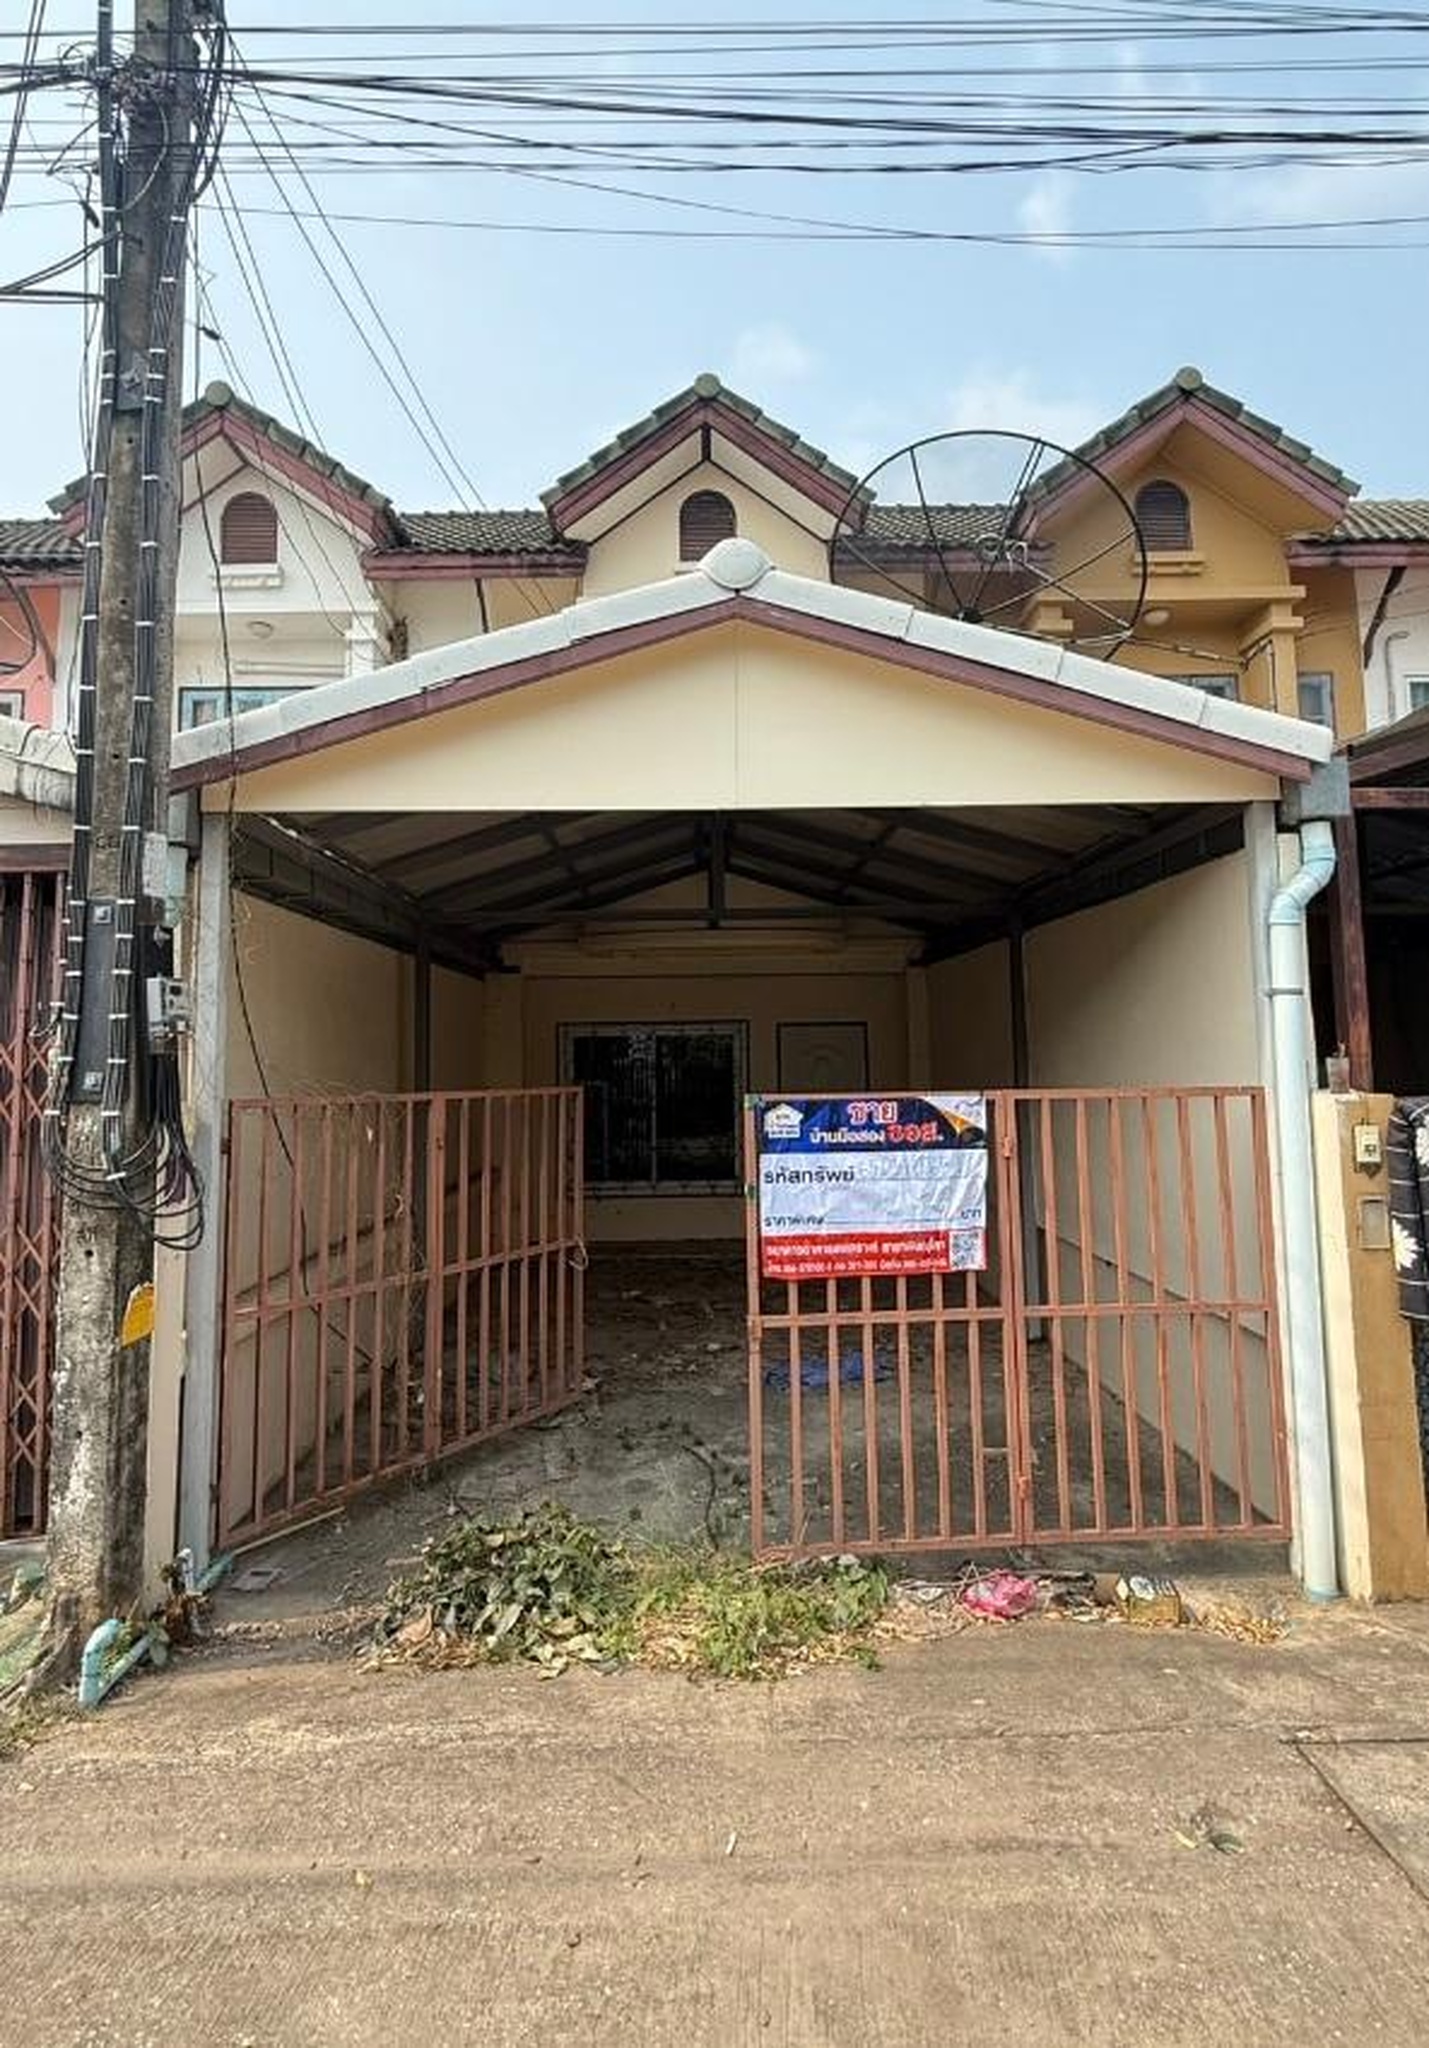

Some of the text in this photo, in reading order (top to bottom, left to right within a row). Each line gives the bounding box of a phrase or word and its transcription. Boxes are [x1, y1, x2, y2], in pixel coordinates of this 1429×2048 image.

[848, 1100, 897, 1124] ขาย
[809, 1127, 885, 1143] บ้านมือสอง
[763, 1166, 855, 1184] รหัสทรัพย์
